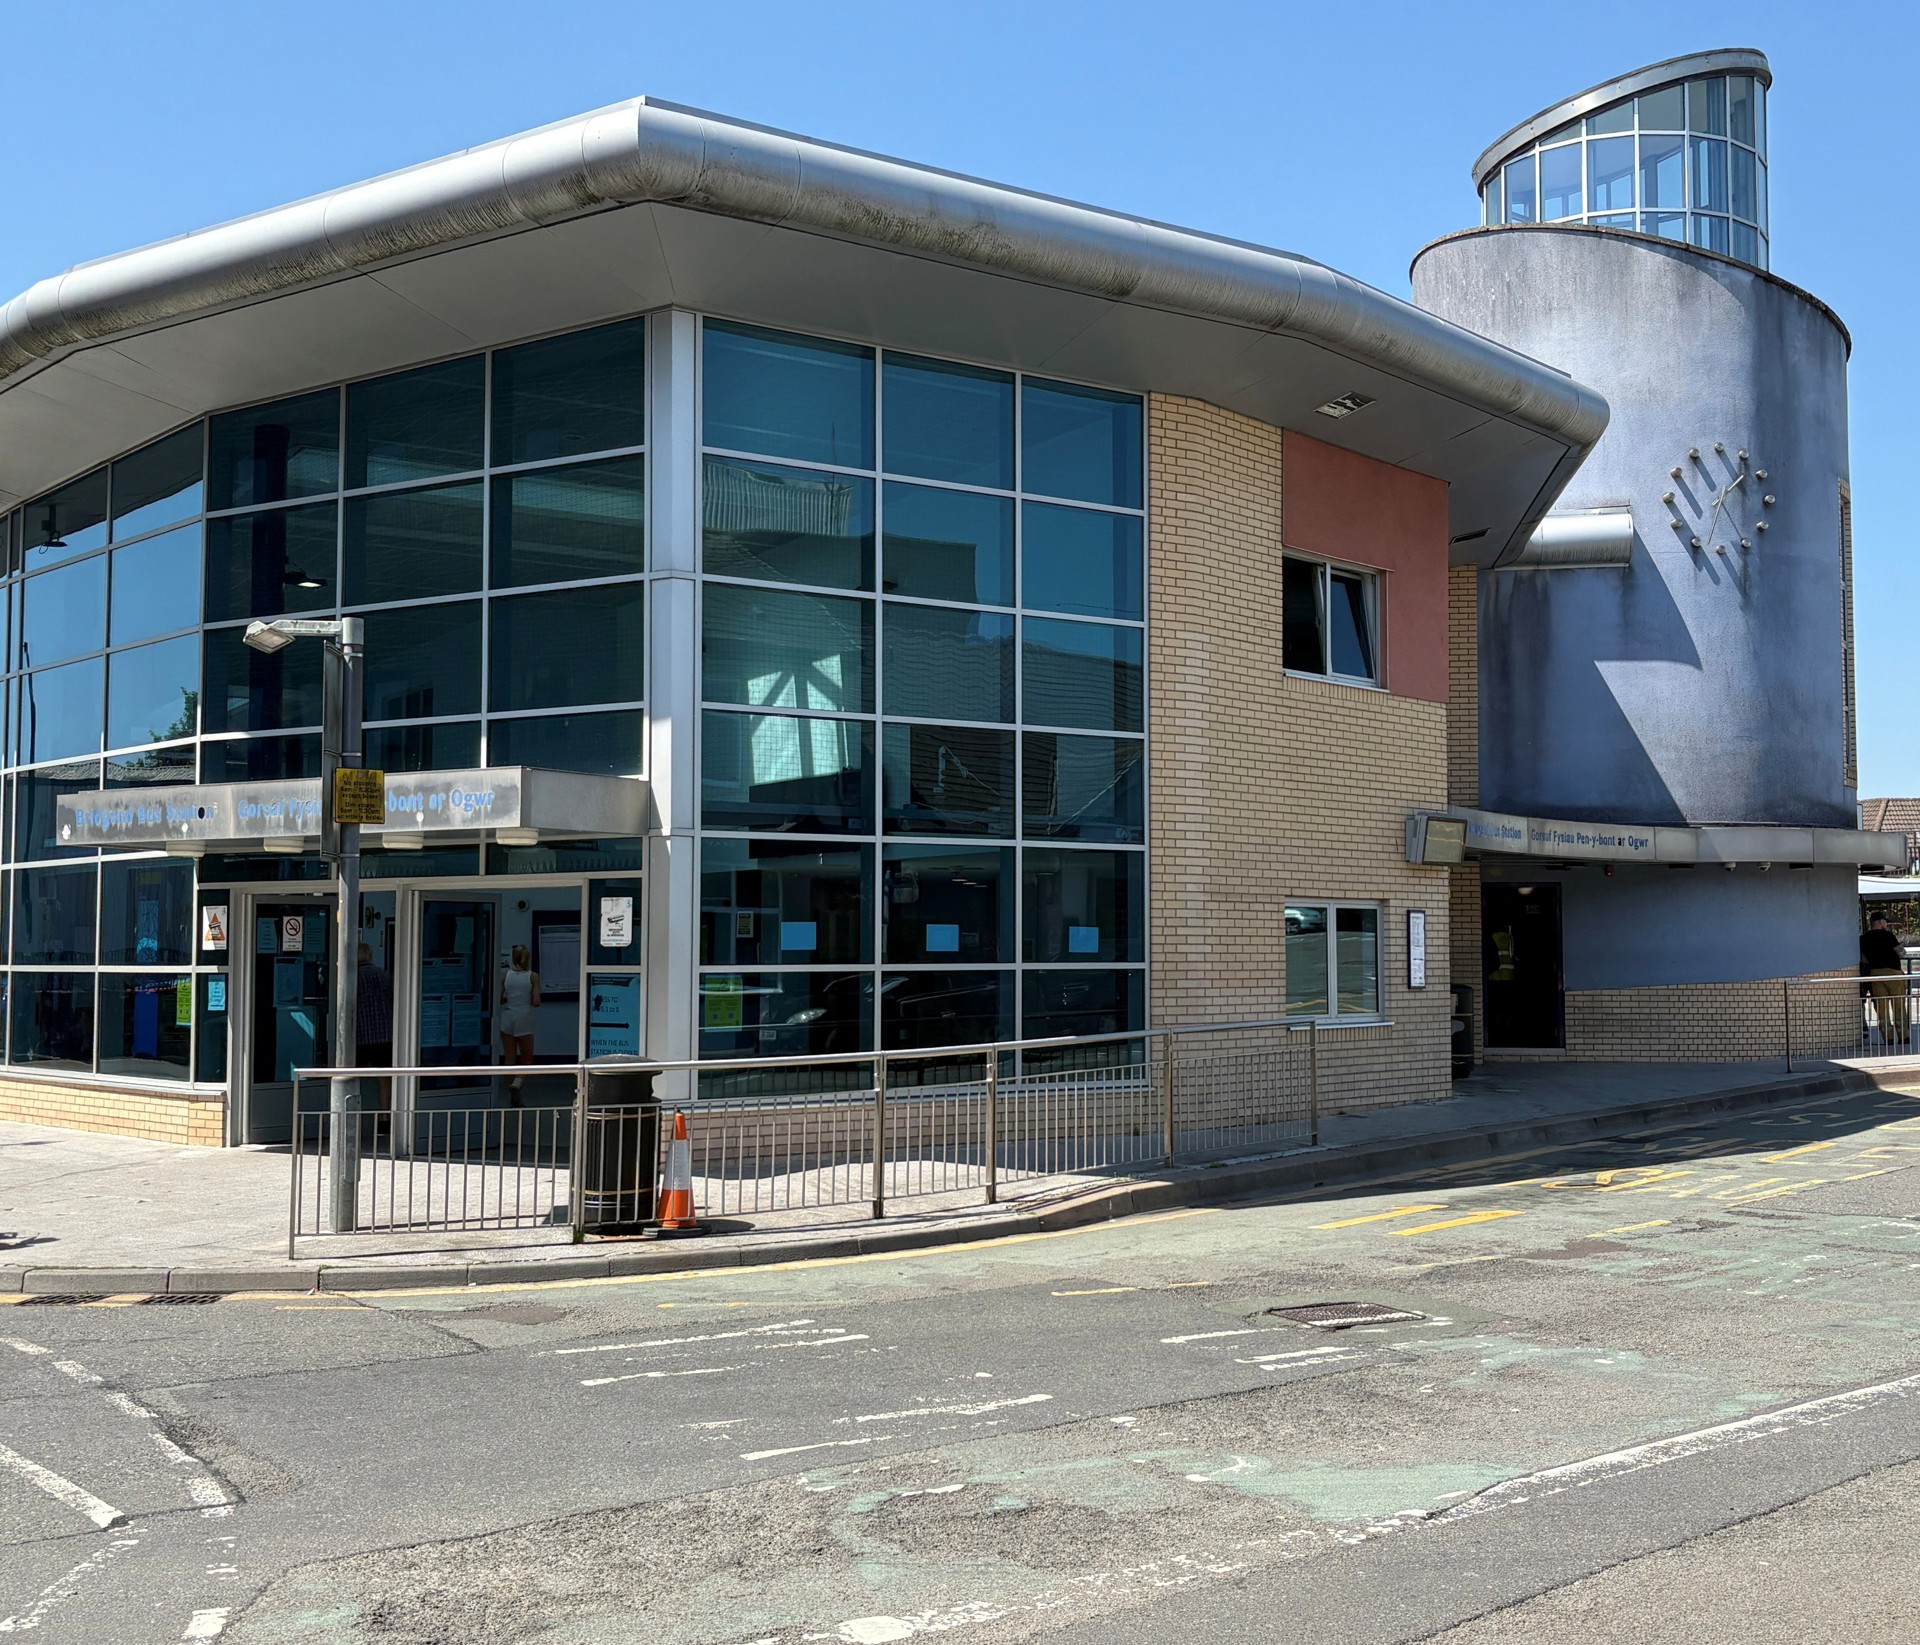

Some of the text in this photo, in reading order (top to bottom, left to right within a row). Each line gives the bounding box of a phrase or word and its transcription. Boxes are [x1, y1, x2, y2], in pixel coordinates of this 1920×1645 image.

[429, 792, 446, 811] ar
[450, 787, 495, 813] Ogwr
[138, 805, 161, 824] Bus
[166, 802, 214, 823] Statin
[1501, 824, 1521, 840] Station
[1553, 831, 1574, 846] Fysiau
[1577, 832, 1616, 848] Pen-y-bont
[1618, 837, 1626, 847] ar
[1628, 835, 1649, 850] Ogwr
